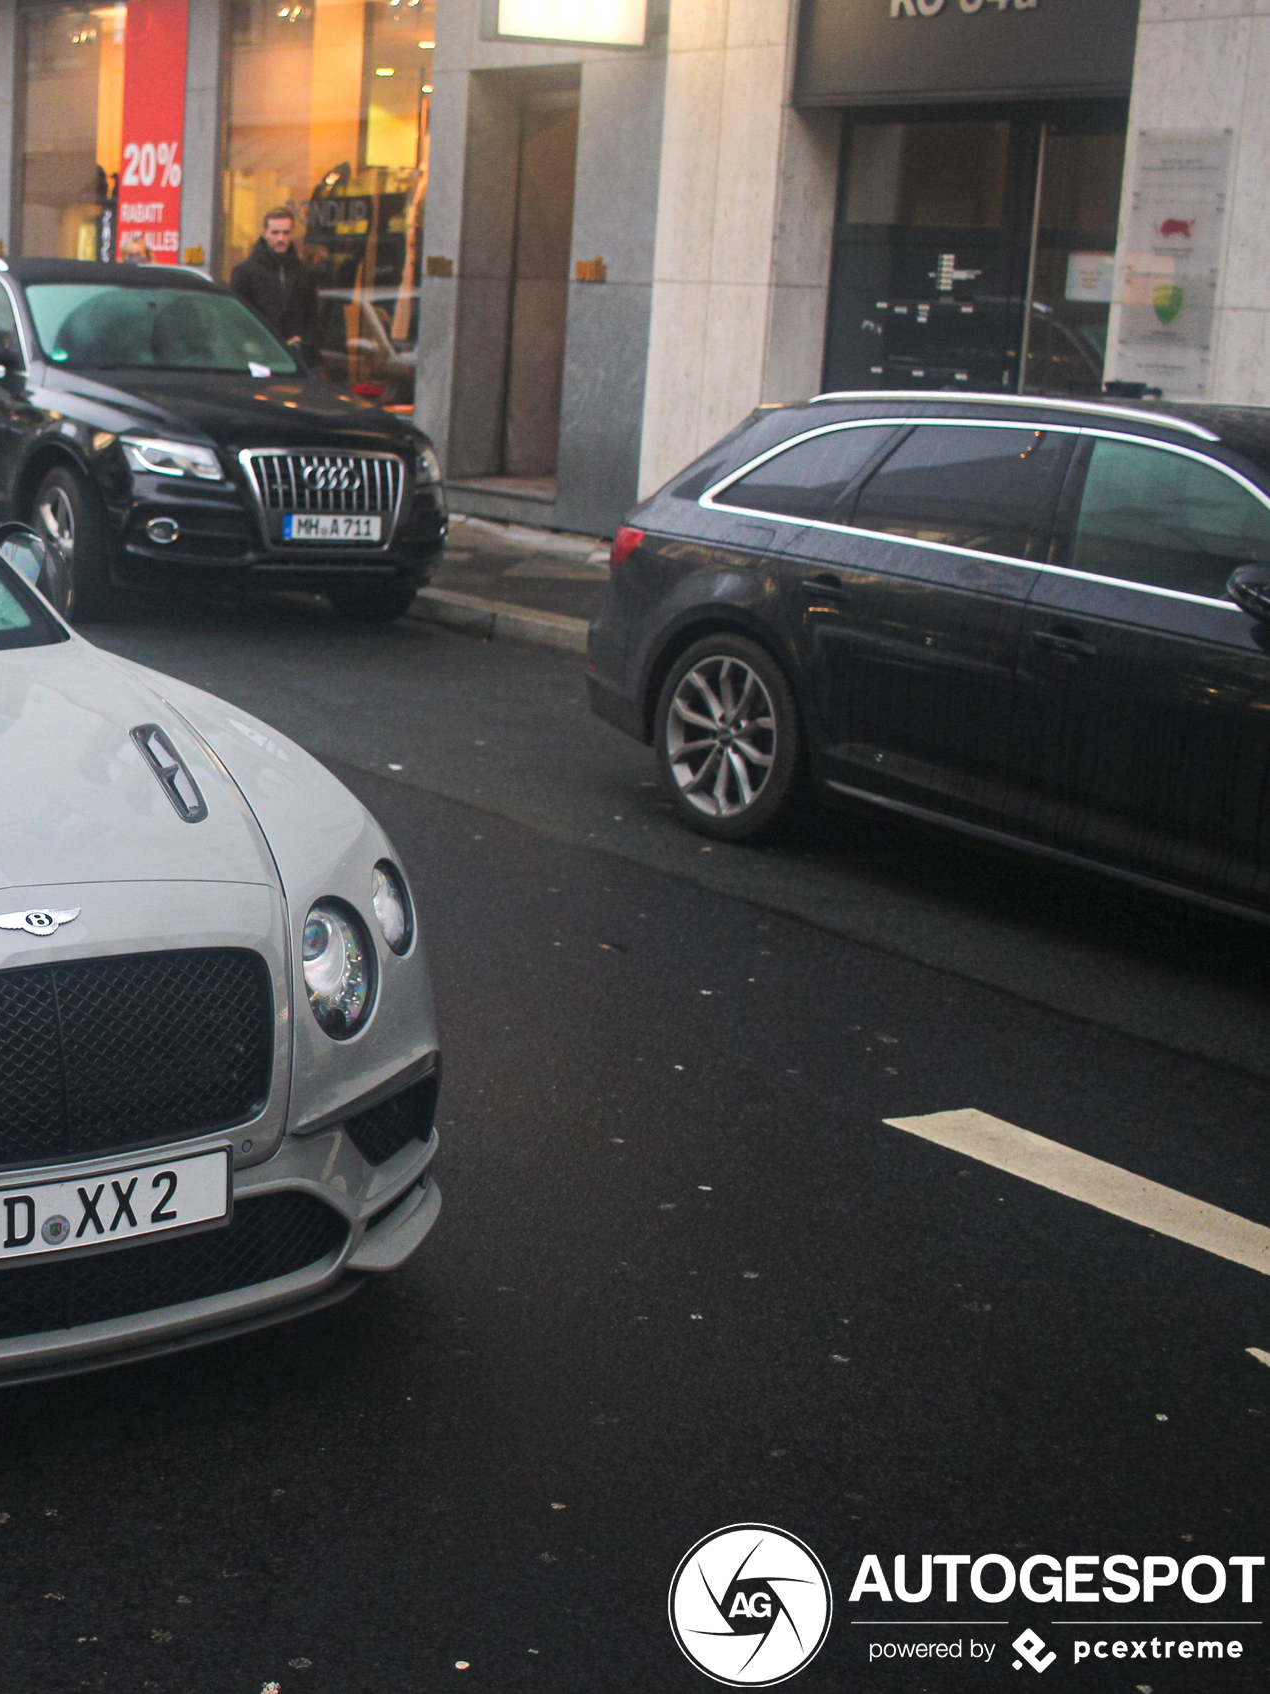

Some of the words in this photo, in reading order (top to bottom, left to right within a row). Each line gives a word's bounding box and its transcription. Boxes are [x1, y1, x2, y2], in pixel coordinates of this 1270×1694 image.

[122, 142, 181, 188] 20%
[120, 201, 165, 223] RABATT
[297, 518, 320, 535] MH
[330, 518, 340, 535] A
[343, 518, 373, 537] 711
[3, 1194, 36, 1249] D
